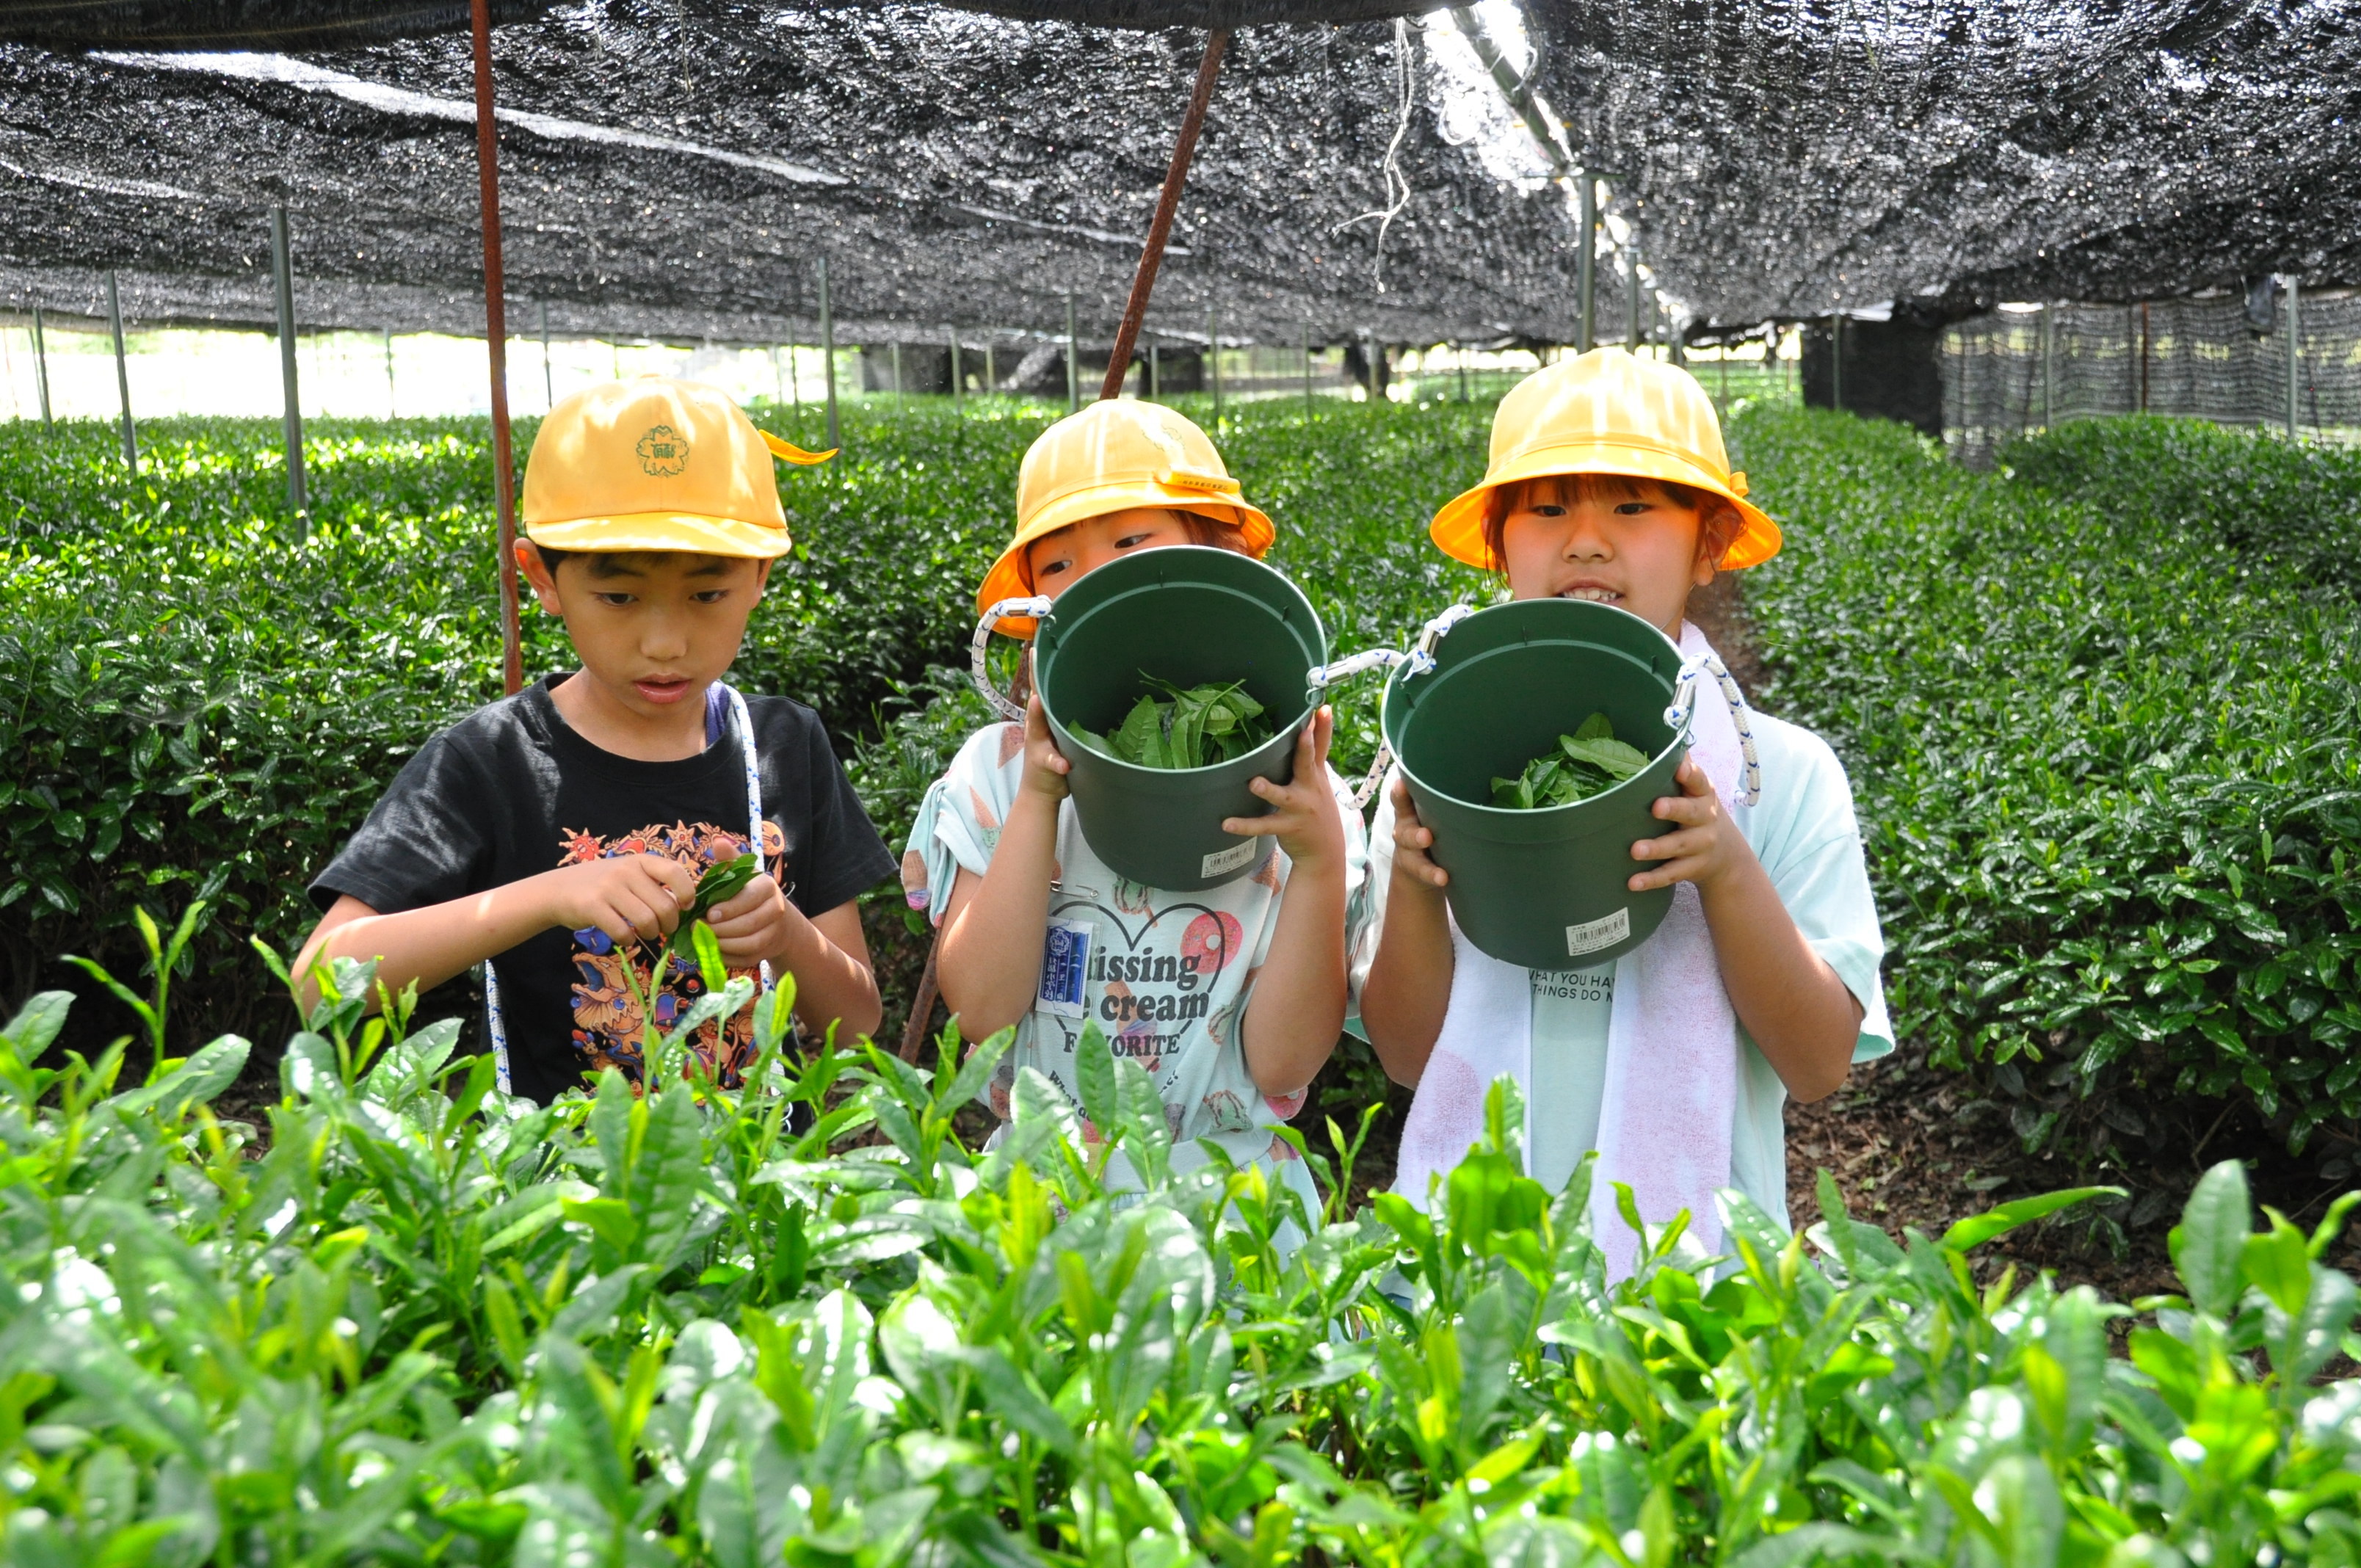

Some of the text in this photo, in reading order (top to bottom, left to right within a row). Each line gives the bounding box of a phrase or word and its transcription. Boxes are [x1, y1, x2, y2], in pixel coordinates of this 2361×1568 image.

[1087, 946, 1202, 991] issing
[1561, 973, 1586, 986] YOU
[1533, 984, 1577, 999] THINGS
[1581, 989, 1600, 1001] DO
[1100, 992, 1210, 1022] cream
[1064, 1031, 1180, 1057] FORITE
